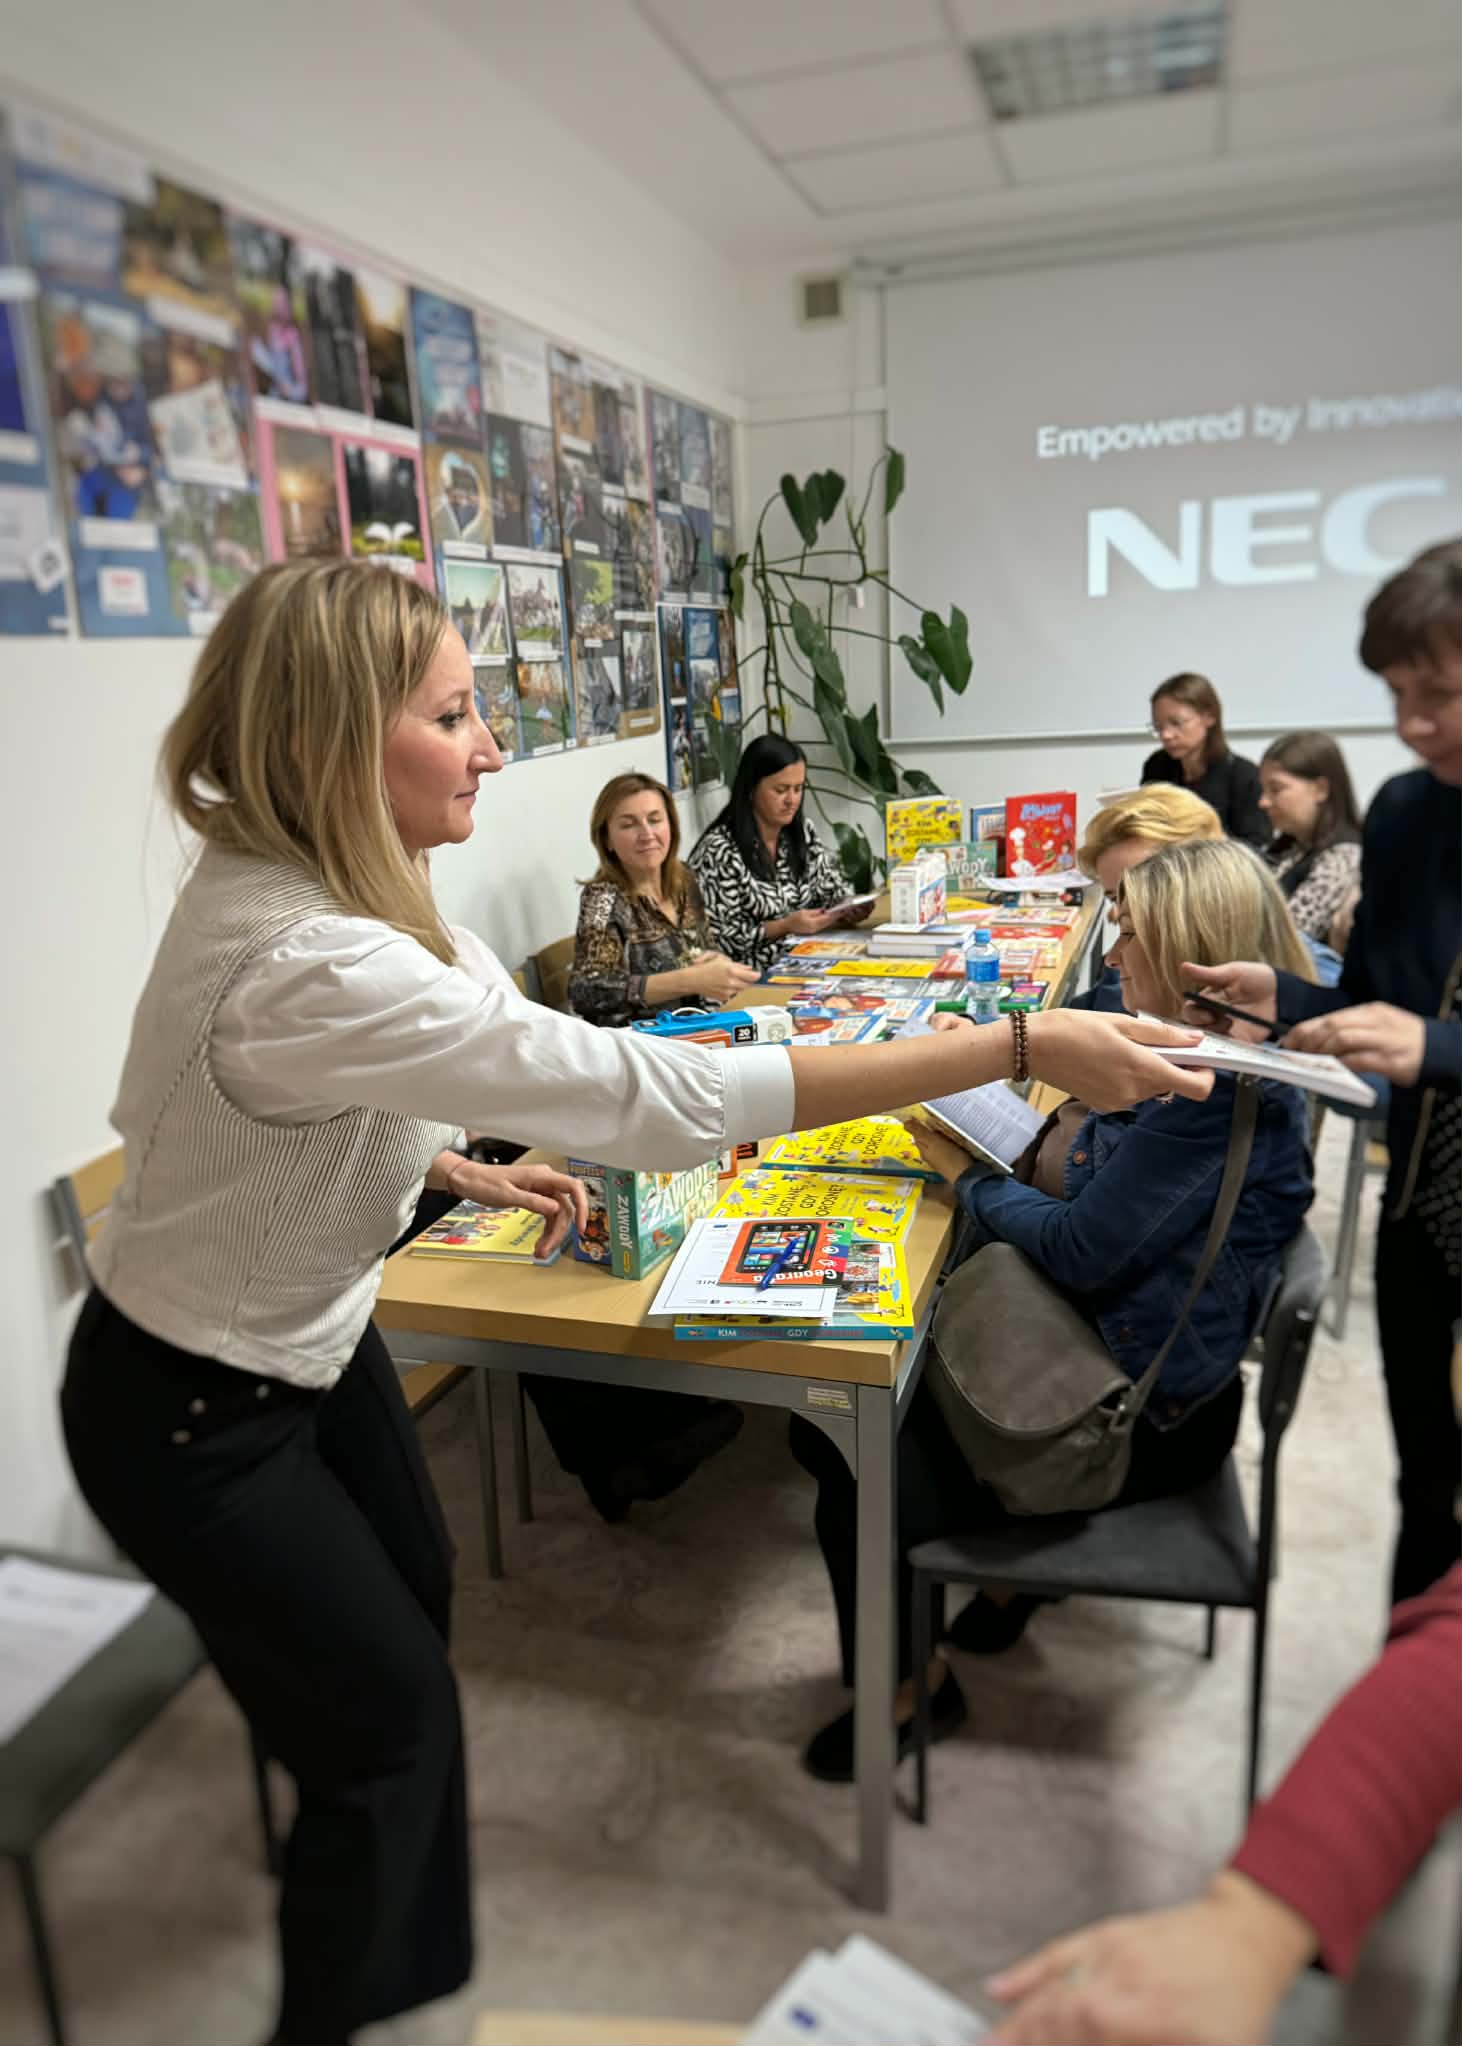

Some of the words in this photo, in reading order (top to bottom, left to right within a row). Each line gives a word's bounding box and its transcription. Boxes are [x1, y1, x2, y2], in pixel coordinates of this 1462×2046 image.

[1037, 405, 1246, 461] Empowered
[1253, 402, 1302, 444] by
[1087, 476, 1448, 597] NEC
[950, 857, 988, 874] WODY
[800, 1193, 818, 1209] GDY
[616, 1194, 633, 1249] ZAWODY
[718, 1328, 737, 1337] KIM
[787, 1328, 809, 1337] GDY
